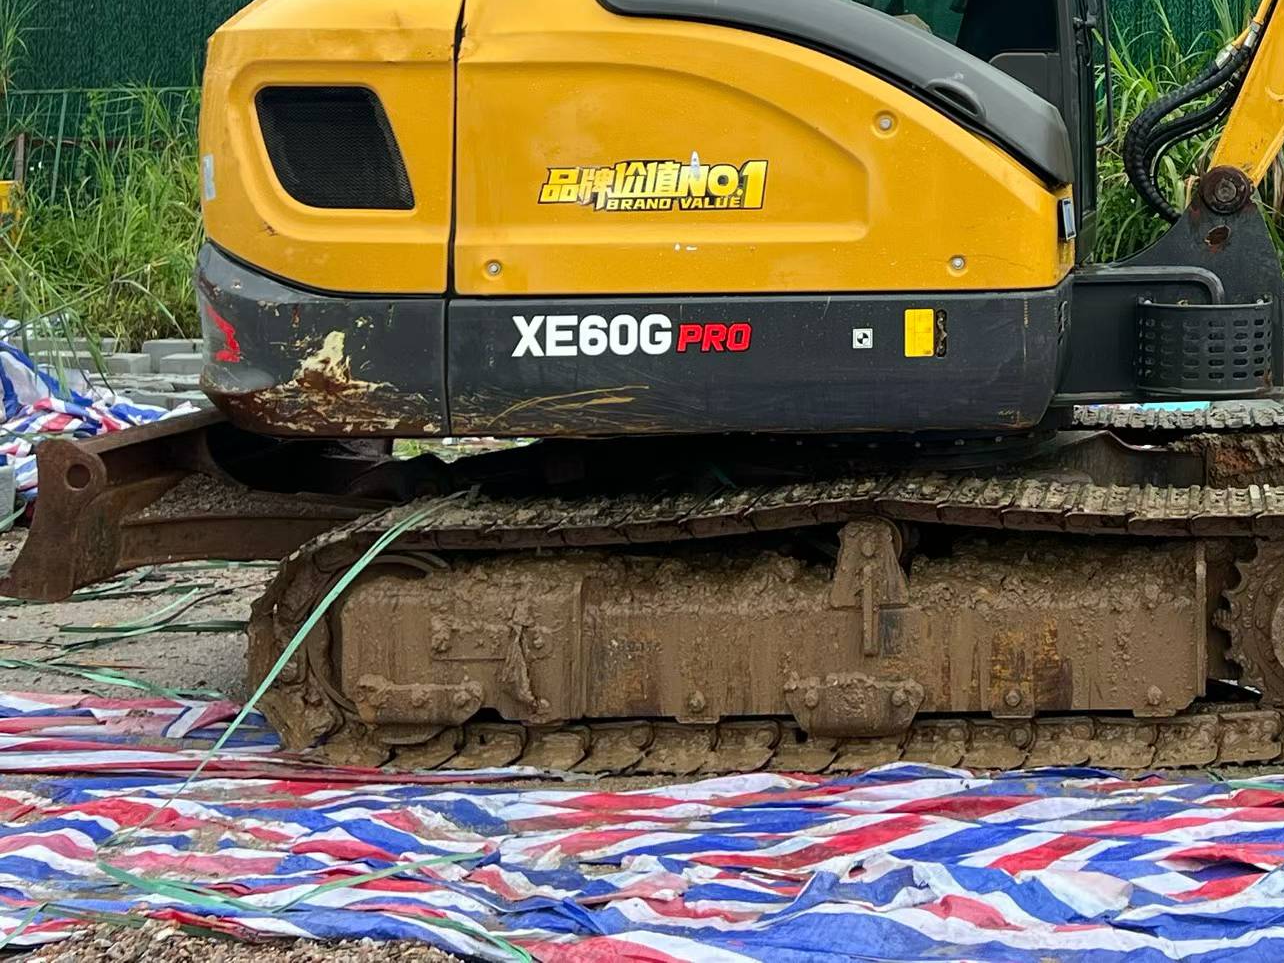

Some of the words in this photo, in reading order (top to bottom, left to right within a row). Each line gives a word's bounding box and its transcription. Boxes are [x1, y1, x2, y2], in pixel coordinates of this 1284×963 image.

[606, 198, 672, 210] BRAND
[680, 197, 742, 209] VALUE
[511, 314, 672, 357] XE60G
[677, 323, 752, 352] PRO
